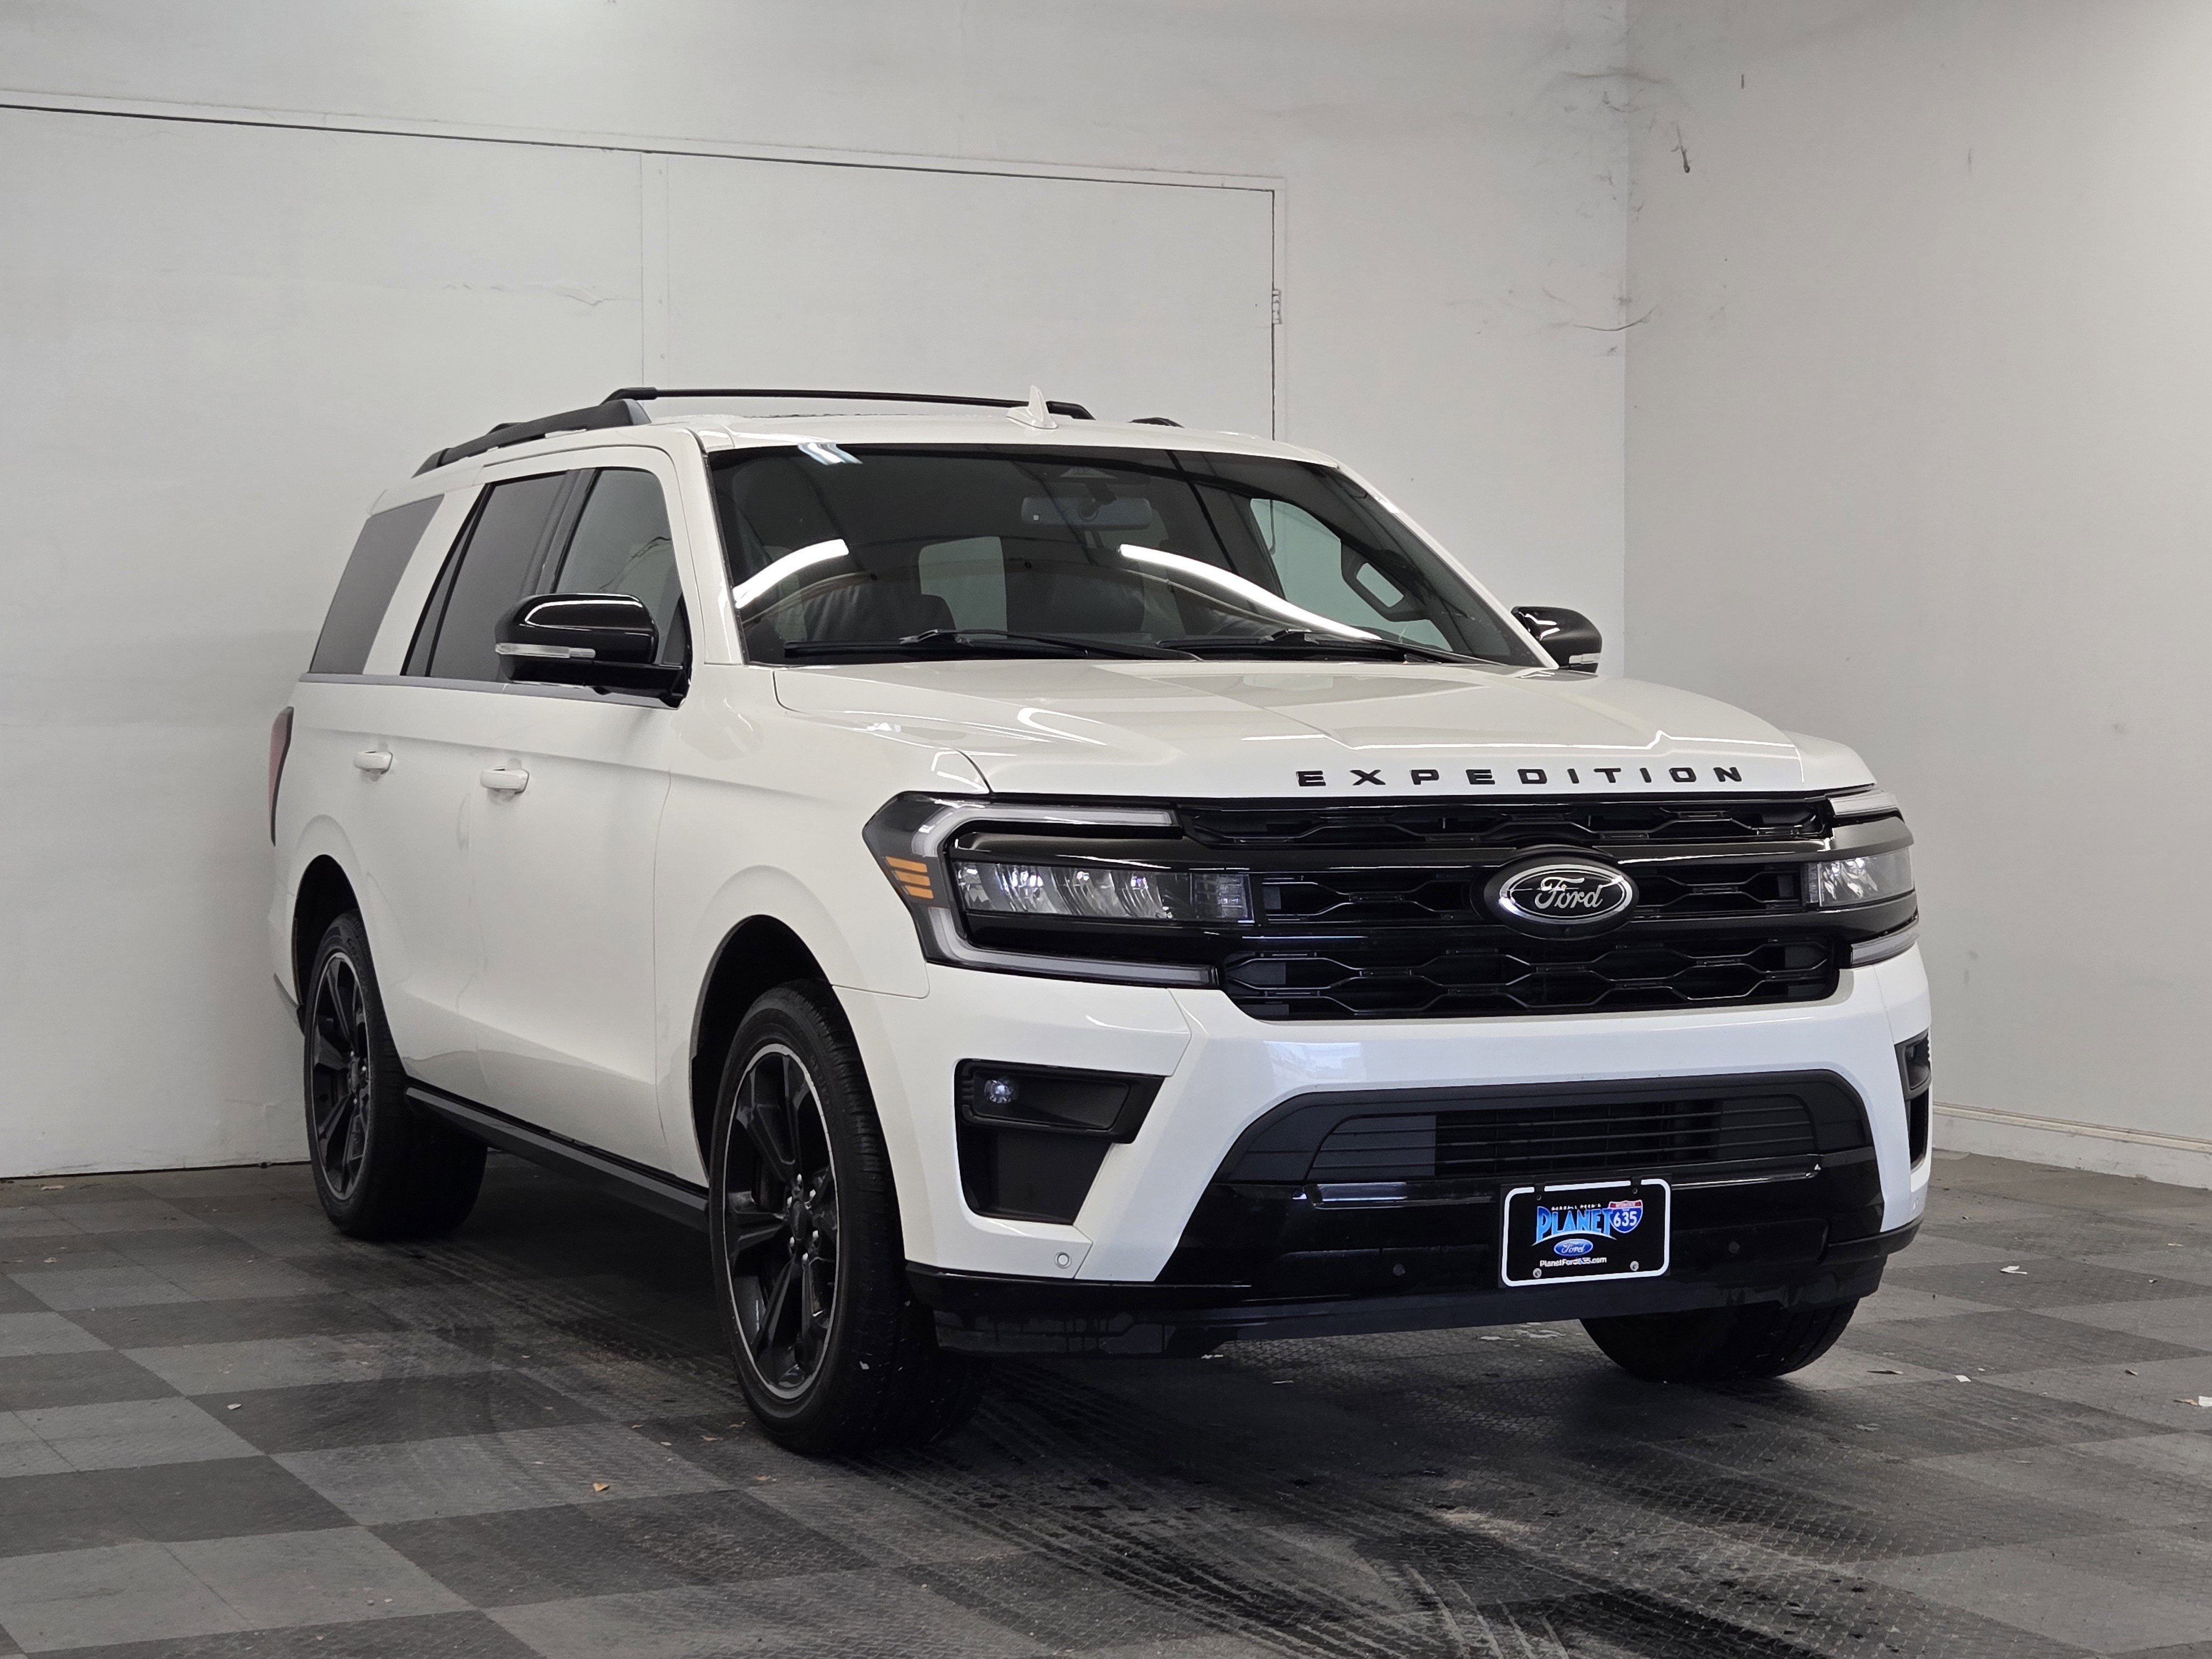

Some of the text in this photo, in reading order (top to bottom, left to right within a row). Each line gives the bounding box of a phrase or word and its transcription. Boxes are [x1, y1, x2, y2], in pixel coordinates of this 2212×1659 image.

[1296, 766, 1743, 787] EXPEDITION
[1535, 877, 1603, 909] Ford
[1536, 1206, 1637, 1242] PLANET 635
[1561, 1243, 1586, 1254] Ford
